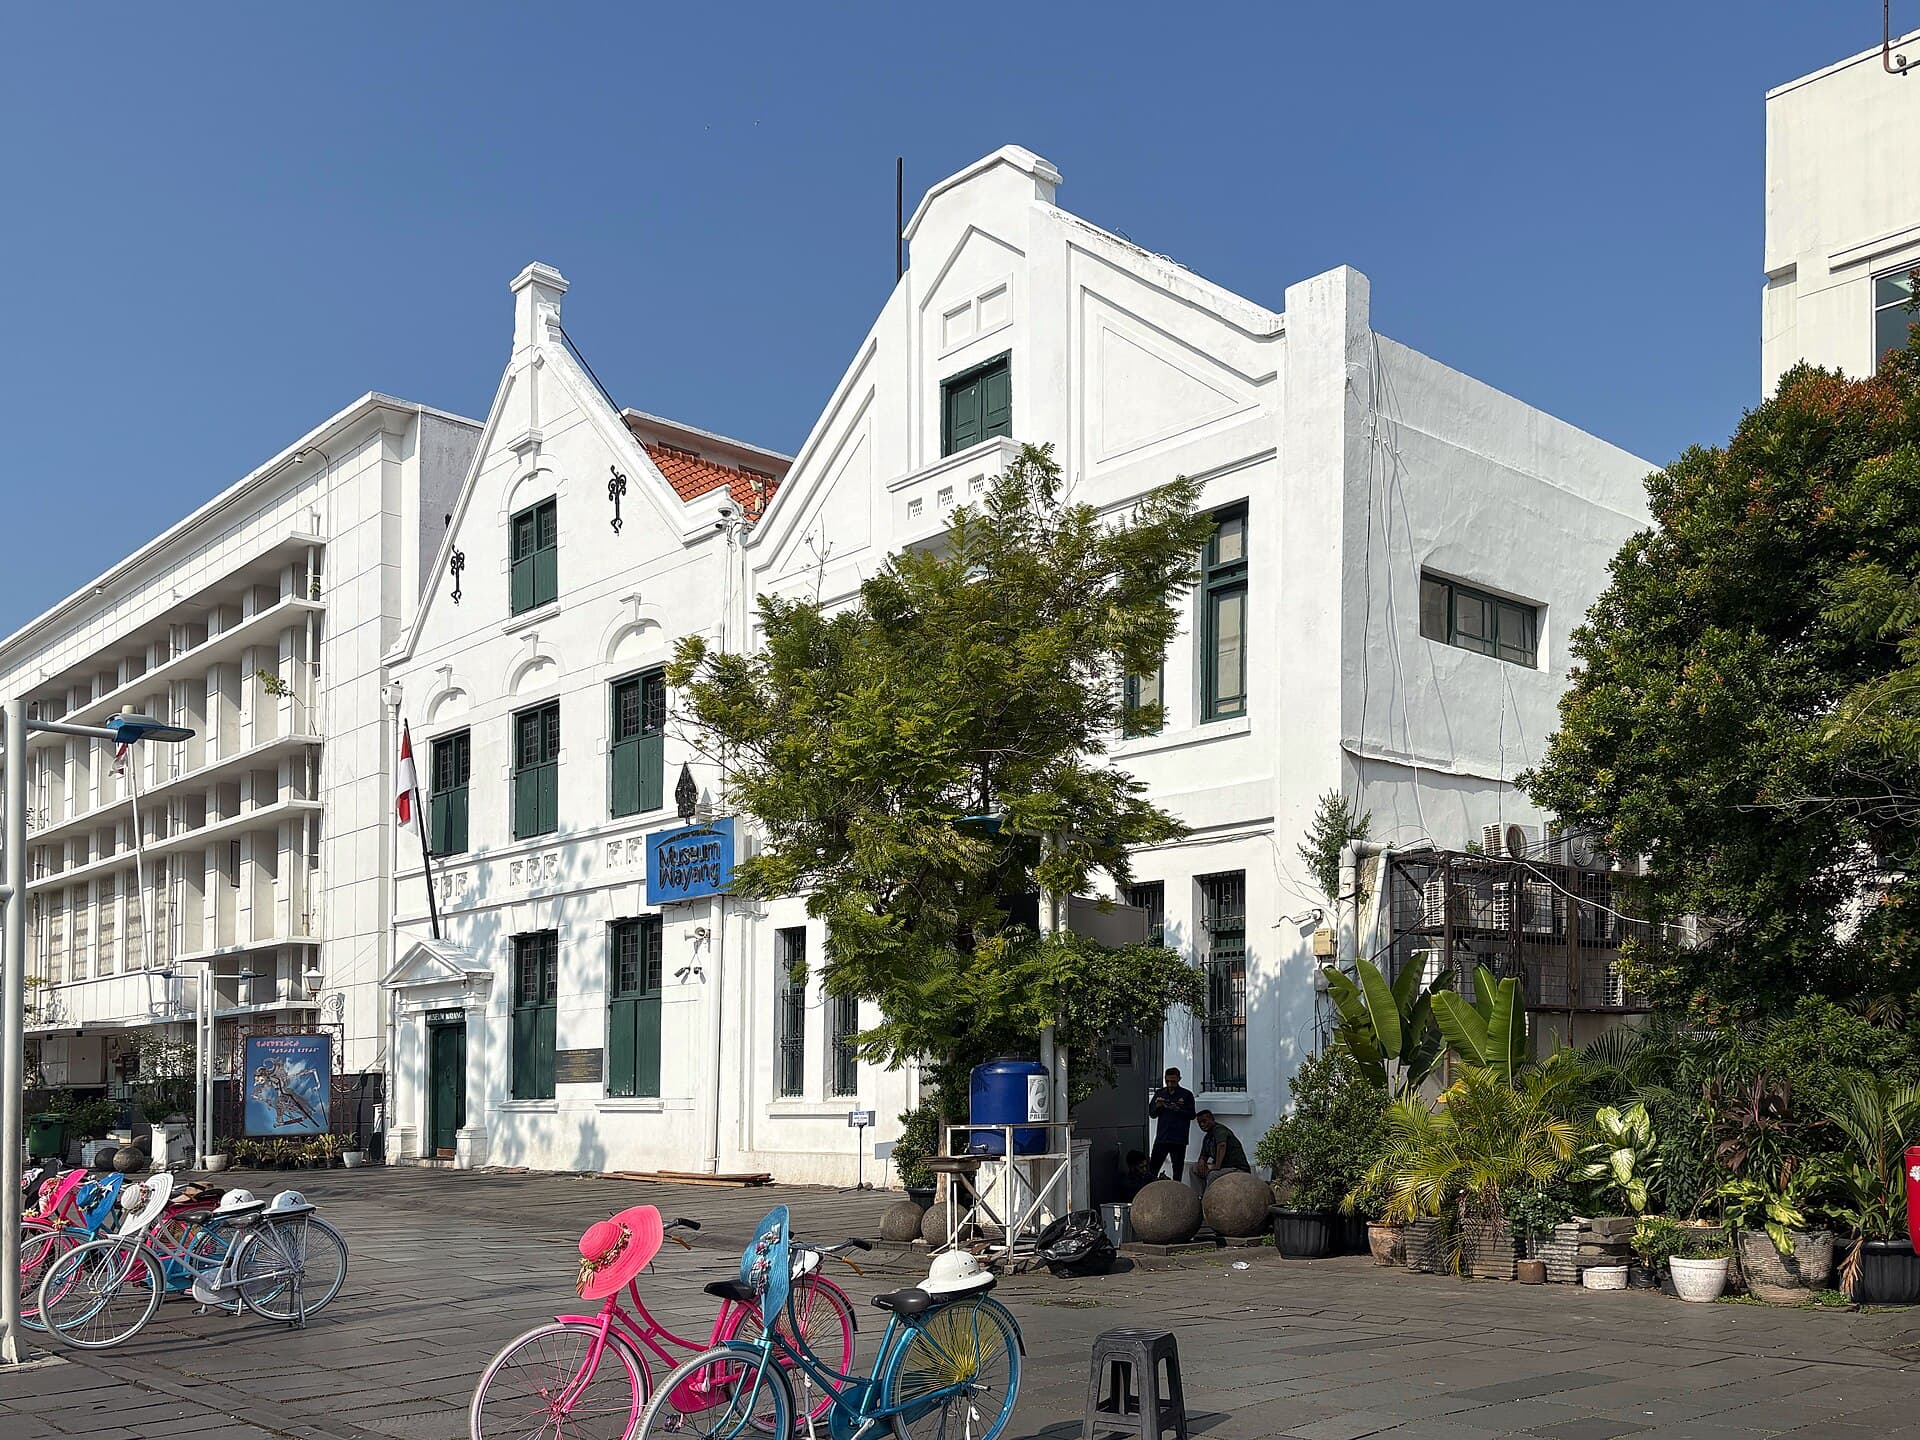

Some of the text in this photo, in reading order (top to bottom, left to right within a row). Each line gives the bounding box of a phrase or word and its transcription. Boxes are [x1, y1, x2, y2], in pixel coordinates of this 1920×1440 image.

[659, 841, 721, 869] Museum
[659, 862, 721, 891] Wayang
[427, 1010, 464, 1021] MUSEUM WAYANG
